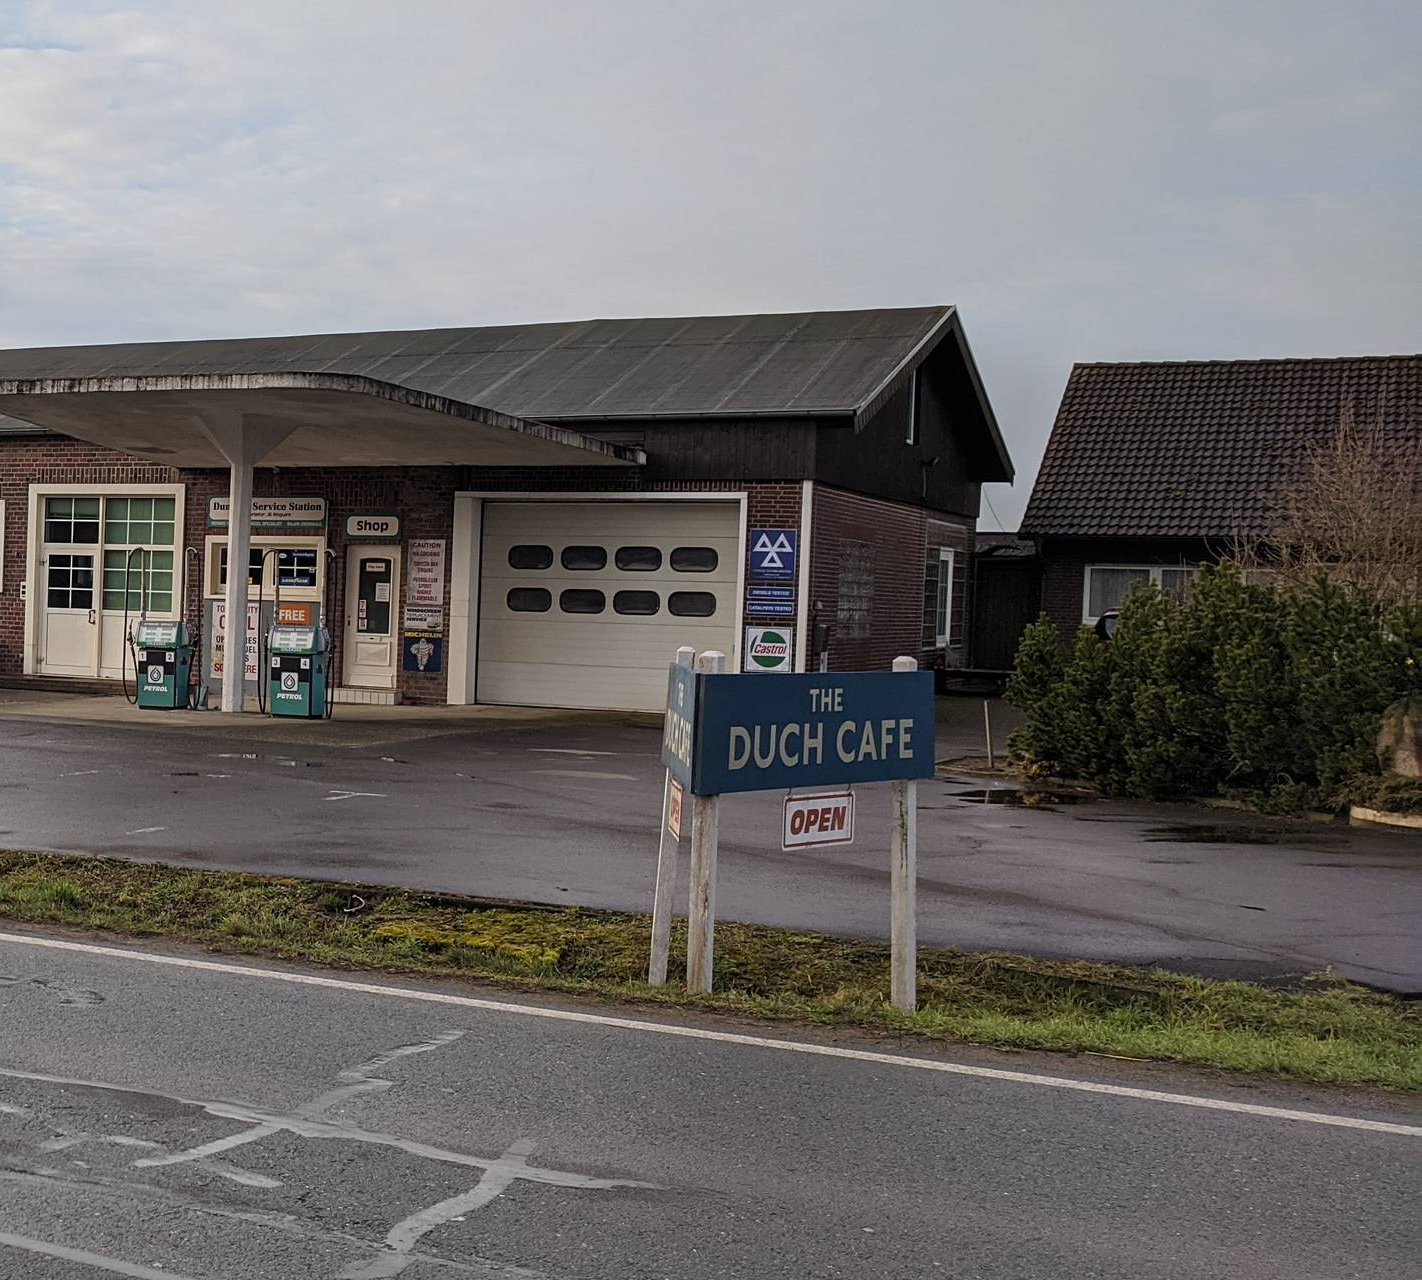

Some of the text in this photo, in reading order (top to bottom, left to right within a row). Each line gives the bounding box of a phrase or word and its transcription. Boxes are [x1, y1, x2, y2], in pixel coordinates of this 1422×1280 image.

[252, 502, 286, 511] Service
[288, 502, 322, 511] Station
[357, 520, 389, 533] Shop
[279, 609, 306, 621] FREE
[754, 642, 787, 656] Castrol
[273, 658, 278, 666] 3
[276, 692, 303, 700] PETROL
[809, 688, 844, 713] THE
[727, 718, 914, 770] DUCH CAFE
[789, 806, 847, 836] OPEN
